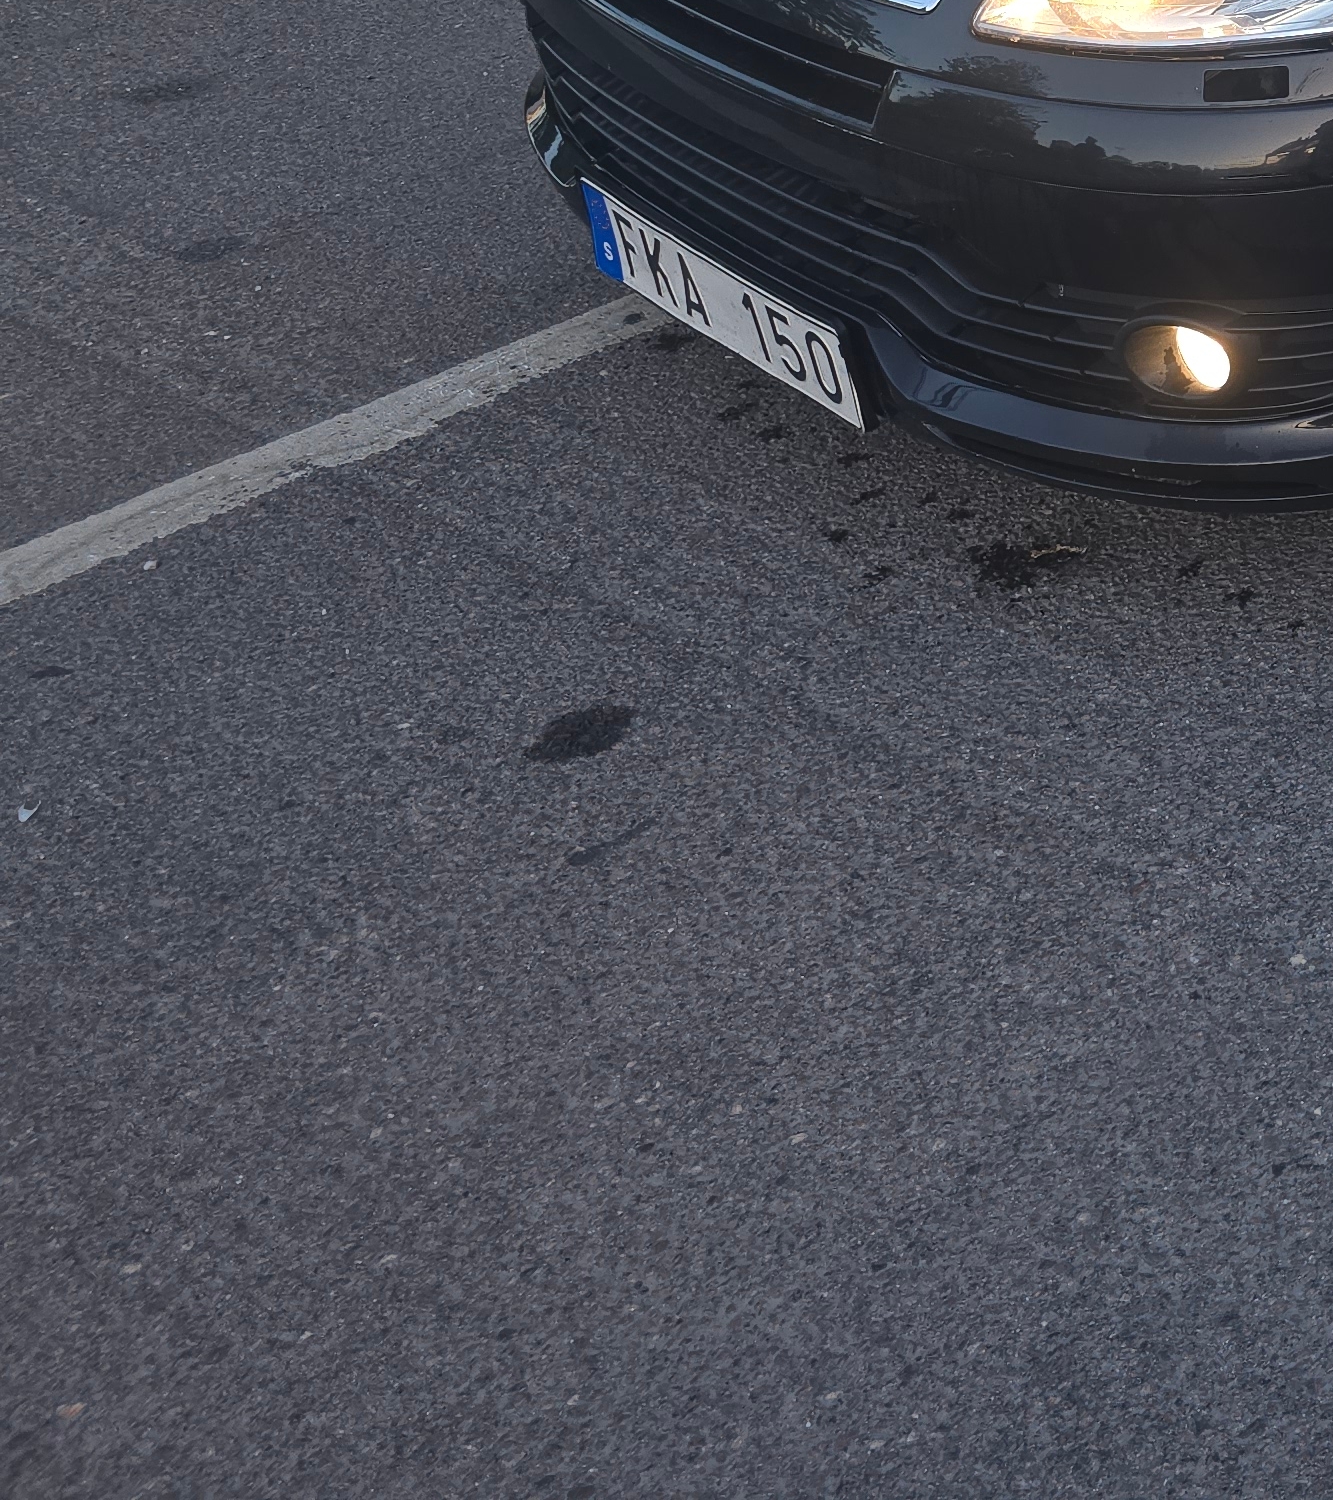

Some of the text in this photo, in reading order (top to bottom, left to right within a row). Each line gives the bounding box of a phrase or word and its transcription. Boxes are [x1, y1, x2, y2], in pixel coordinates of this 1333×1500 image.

[603, 241, 614, 261] S
[611, 209, 843, 405] FKA 150
